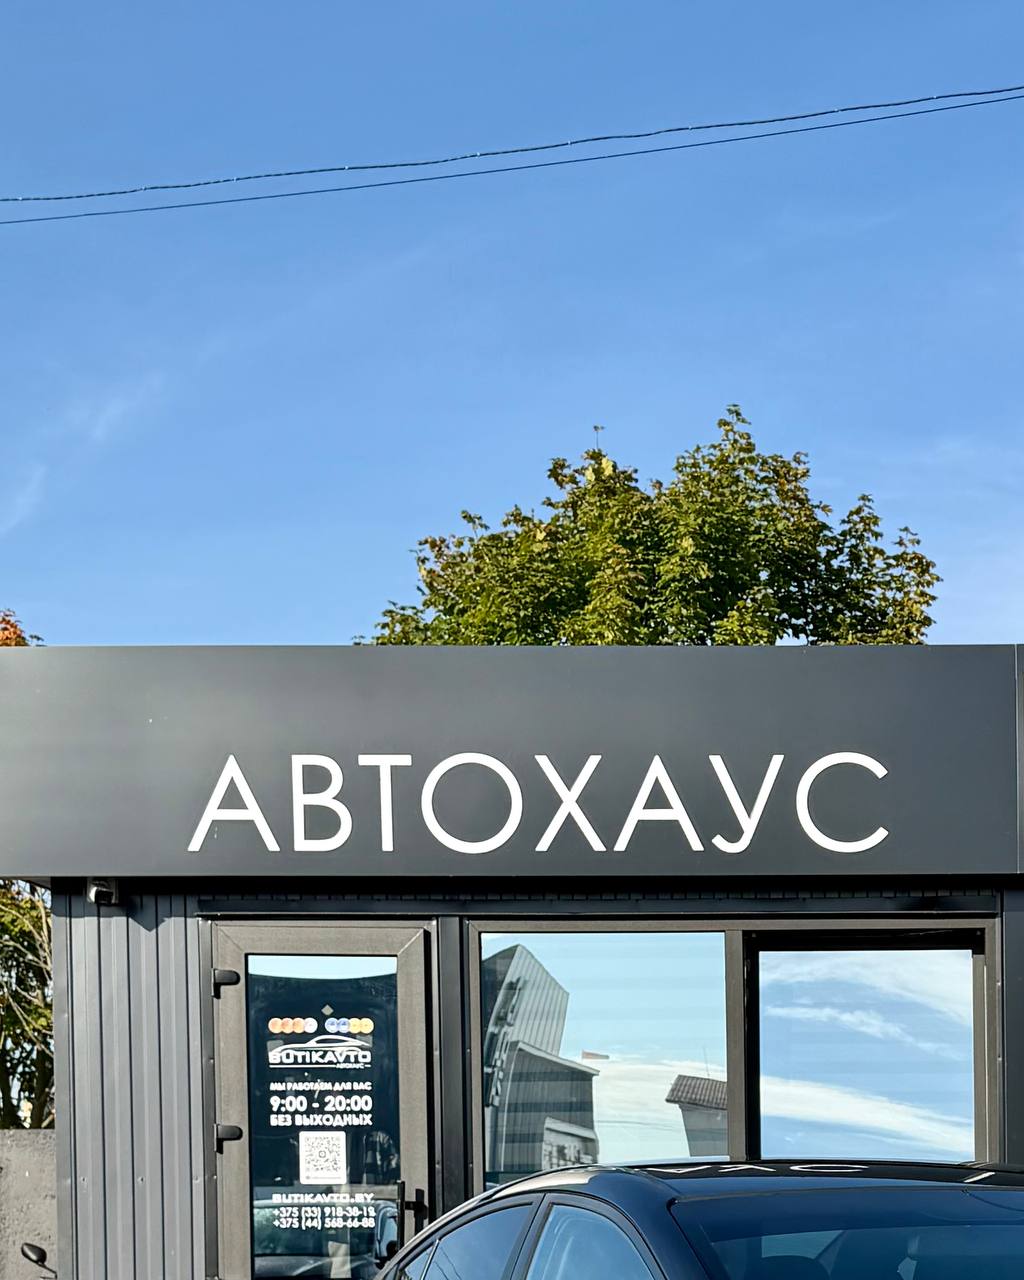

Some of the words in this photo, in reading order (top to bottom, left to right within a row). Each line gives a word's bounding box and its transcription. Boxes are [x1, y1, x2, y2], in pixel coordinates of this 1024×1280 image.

[187, 752, 889, 855] АВТОХАУС
[269, 1050, 371, 1064] BUTIKAVTO
[270, 1095, 307, 1112] 9:00
[324, 1095, 372, 1111] 20:00
[270, 1114, 292, 1126] БЕЗ
[294, 1114, 372, 1127] ВЫХОДНЫХ
[272, 1193, 374, 1203] BUTIKAVTO.BY
[273, 1207, 299, 1217] +375
[302, 1207, 321, 1218] (33)
[273, 1217, 299, 1228] +375
[302, 1217, 321, 1230] (44)
